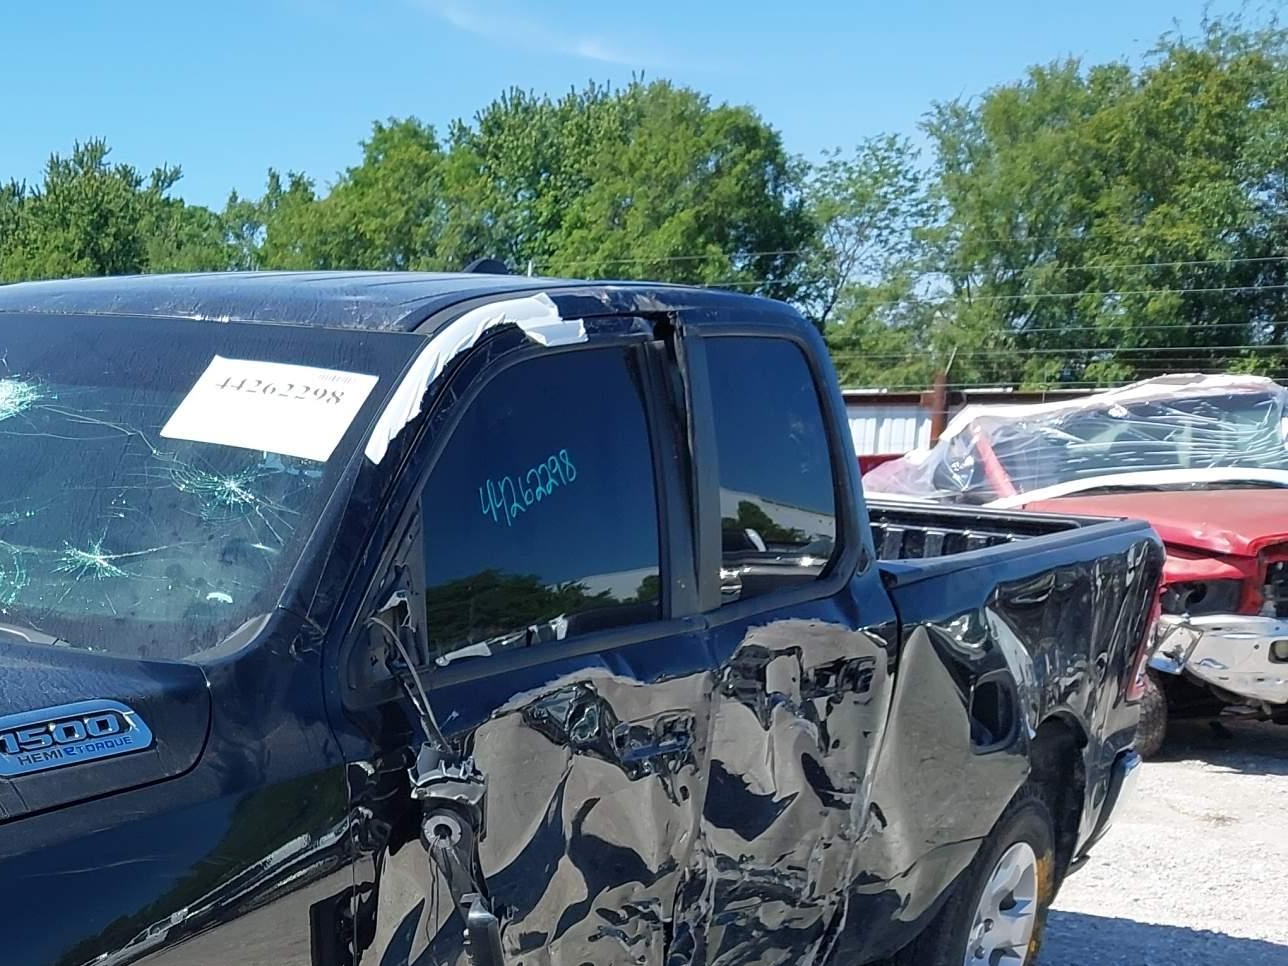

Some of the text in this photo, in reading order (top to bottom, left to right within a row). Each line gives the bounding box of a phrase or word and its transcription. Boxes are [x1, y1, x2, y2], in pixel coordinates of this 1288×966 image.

[216, 376, 345, 405] 44262298
[479, 449, 577, 527] 44262298
[17, 750, 62, 766] HEMI
